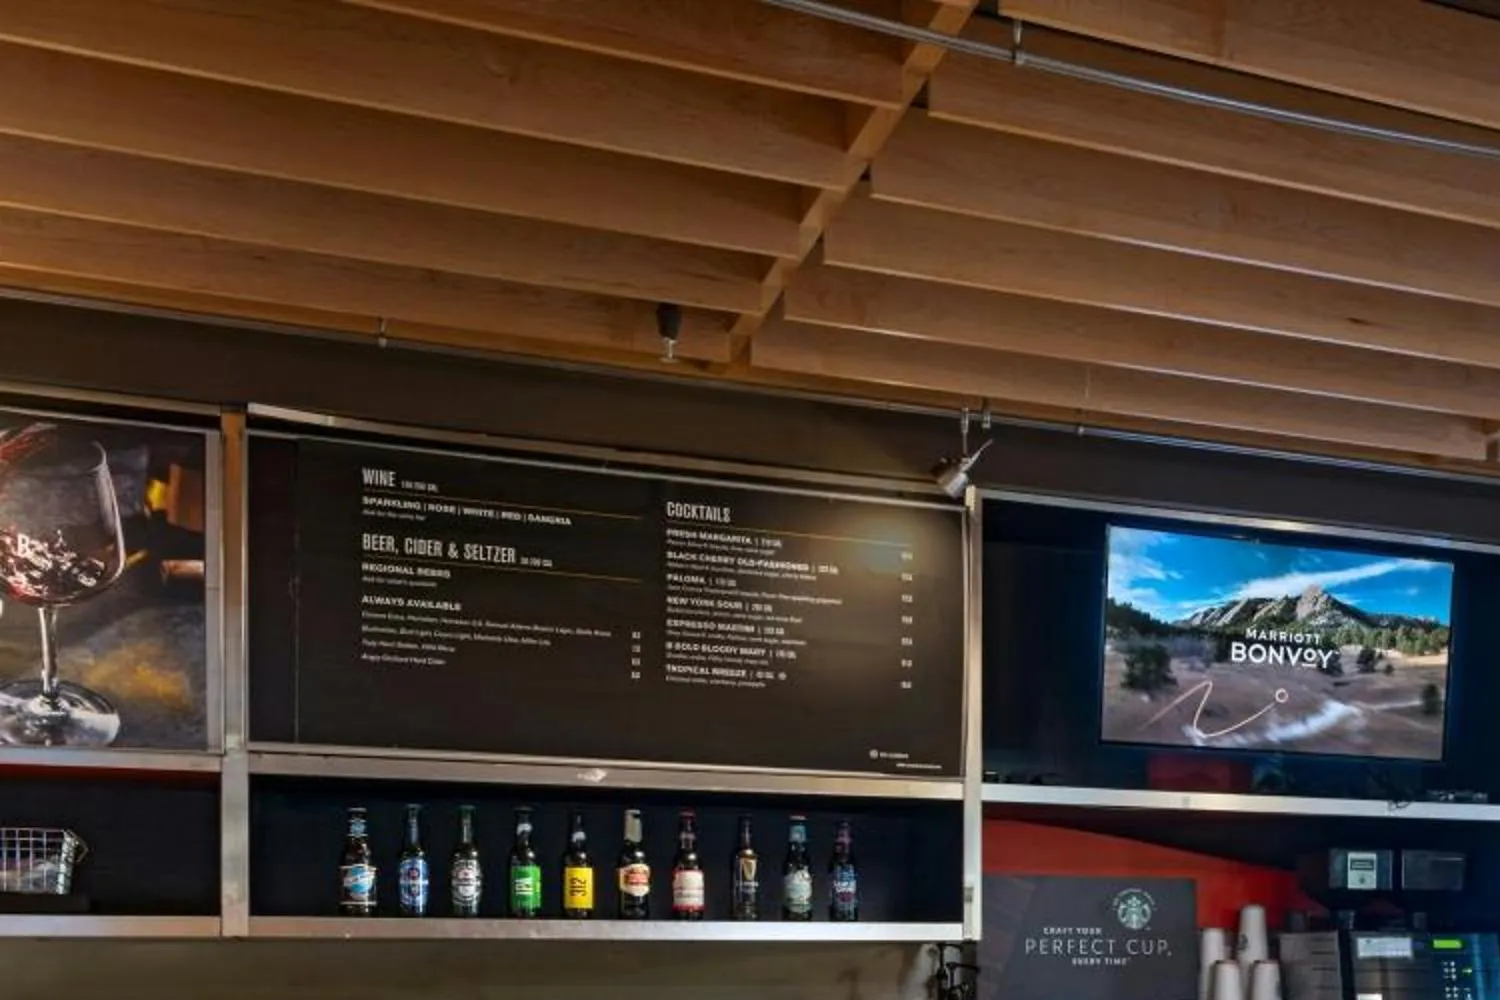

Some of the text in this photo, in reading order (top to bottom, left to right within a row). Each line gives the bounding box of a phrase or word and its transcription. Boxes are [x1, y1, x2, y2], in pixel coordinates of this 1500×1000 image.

[362, 467, 396, 487] WINE
[666, 501, 731, 523] COCKTAILS
[362, 533, 399, 555] BEER,
[404, 537, 443, 558] CIDER
[448, 542, 459, 559] &
[464, 543, 516, 564] SELTZER
[1245, 628, 1321, 645] MARRIOTT
[1231, 641, 1333, 669] BONVOY
[1043, 927, 1073, 935] CRAFT
[1025, 938, 1173, 957] PERFECT CUP.
